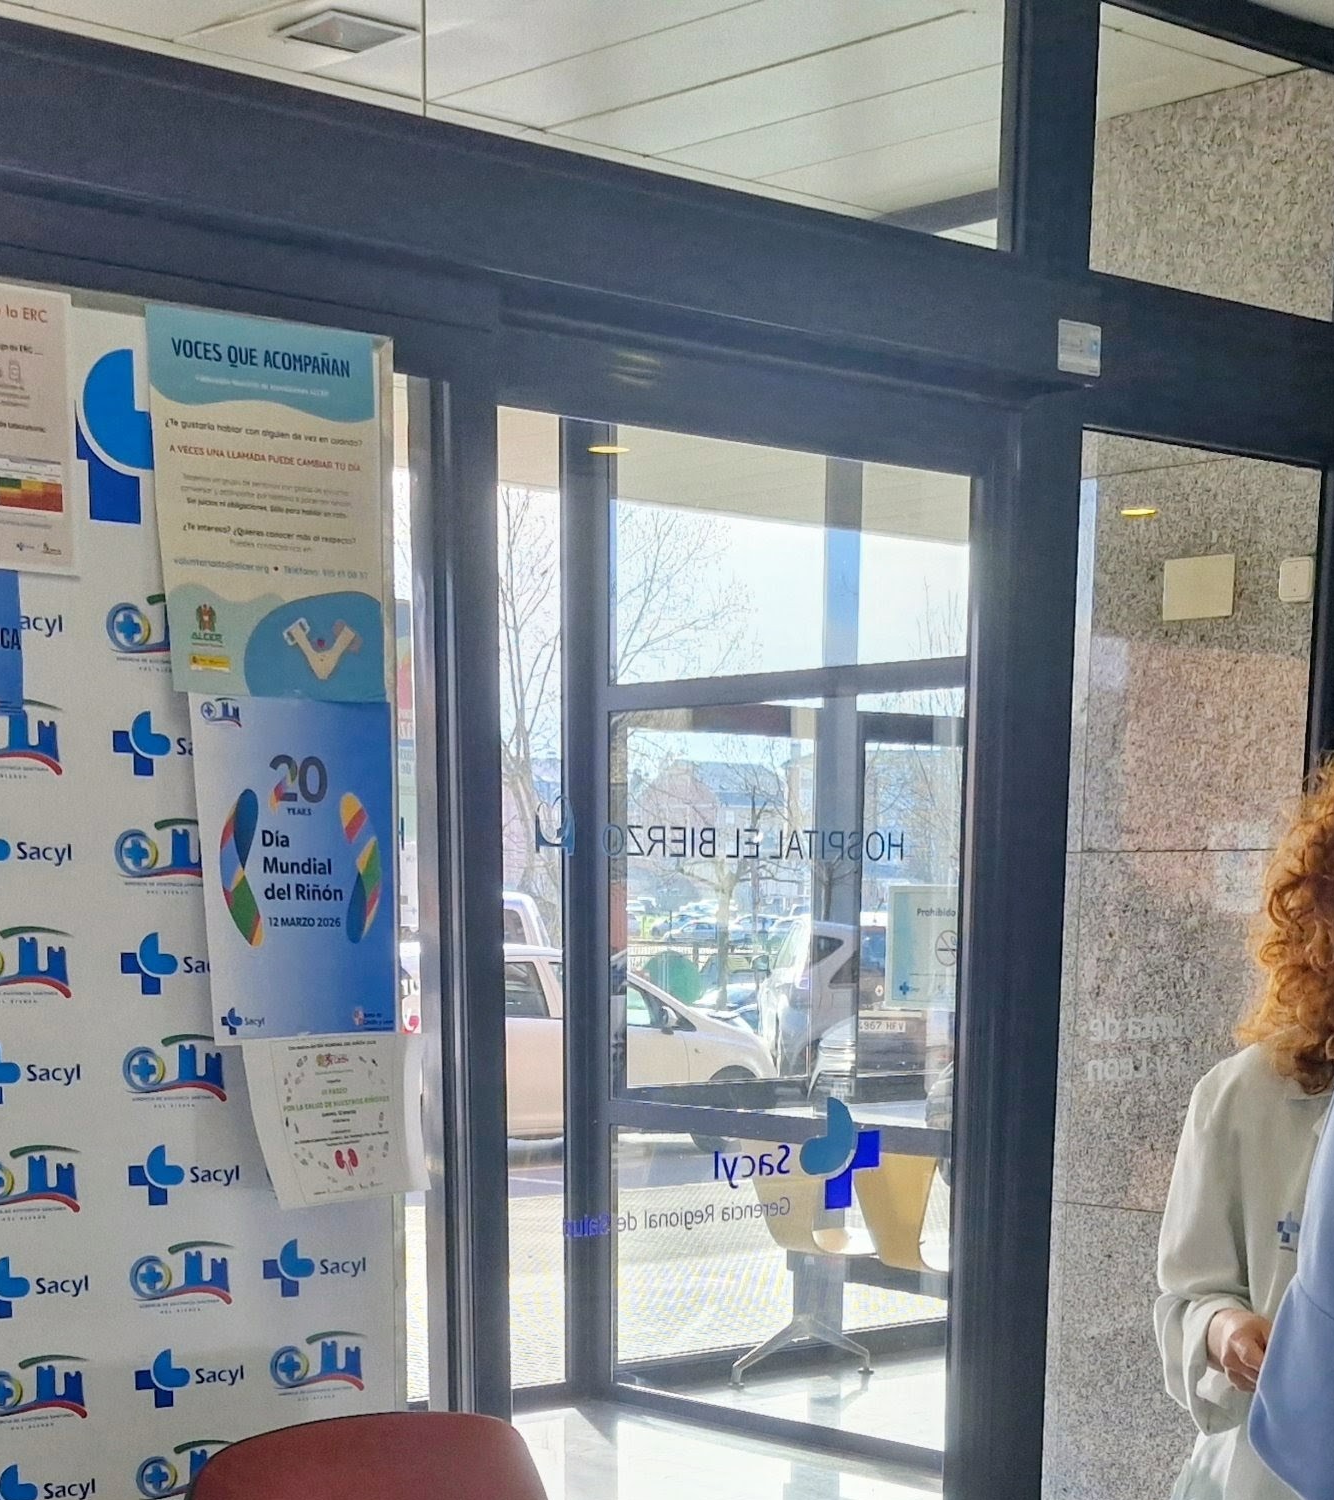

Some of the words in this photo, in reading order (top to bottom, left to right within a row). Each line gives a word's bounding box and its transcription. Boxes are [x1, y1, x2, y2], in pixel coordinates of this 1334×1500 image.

[6, 304, 18, 319] la
[22, 307, 48, 324] ERC
[171, 337, 223, 363] VOCES
[227, 345, 259, 369] QUE
[263, 350, 351, 379] ACOMPAÑAN
[169, 444, 176, 453] A
[178, 444, 205, 456] VECES
[206, 448, 225, 459] UNA
[227, 450, 266, 463] LLAMADA
[268, 453, 295, 466] PUEDE
[297, 457, 333, 470] CAMBIAR
[335, 461, 346, 471] TU
[269, 754, 329, 804] 20
[261, 828, 291, 848] Día
[16, 841, 73, 868] Sacyl
[263, 856, 332, 876] Mundial
[263, 882, 292, 902] del
[294, 882, 345, 903] Riñón
[267, 917, 280, 928] 12
[280, 917, 316, 928] MARZO
[316, 916, 342, 928] 2026
[916, 906, 957, 918] Prohibido
[243, 1016, 265, 1028] Sacyl
[25, 1061, 82, 1088] Sacyl
[188, 1163, 242, 1187] Sacyl
[318, 1254, 368, 1277] Sacyl
[34, 1274, 90, 1299] Sacyl
[193, 1363, 245, 1388] Sacyl
